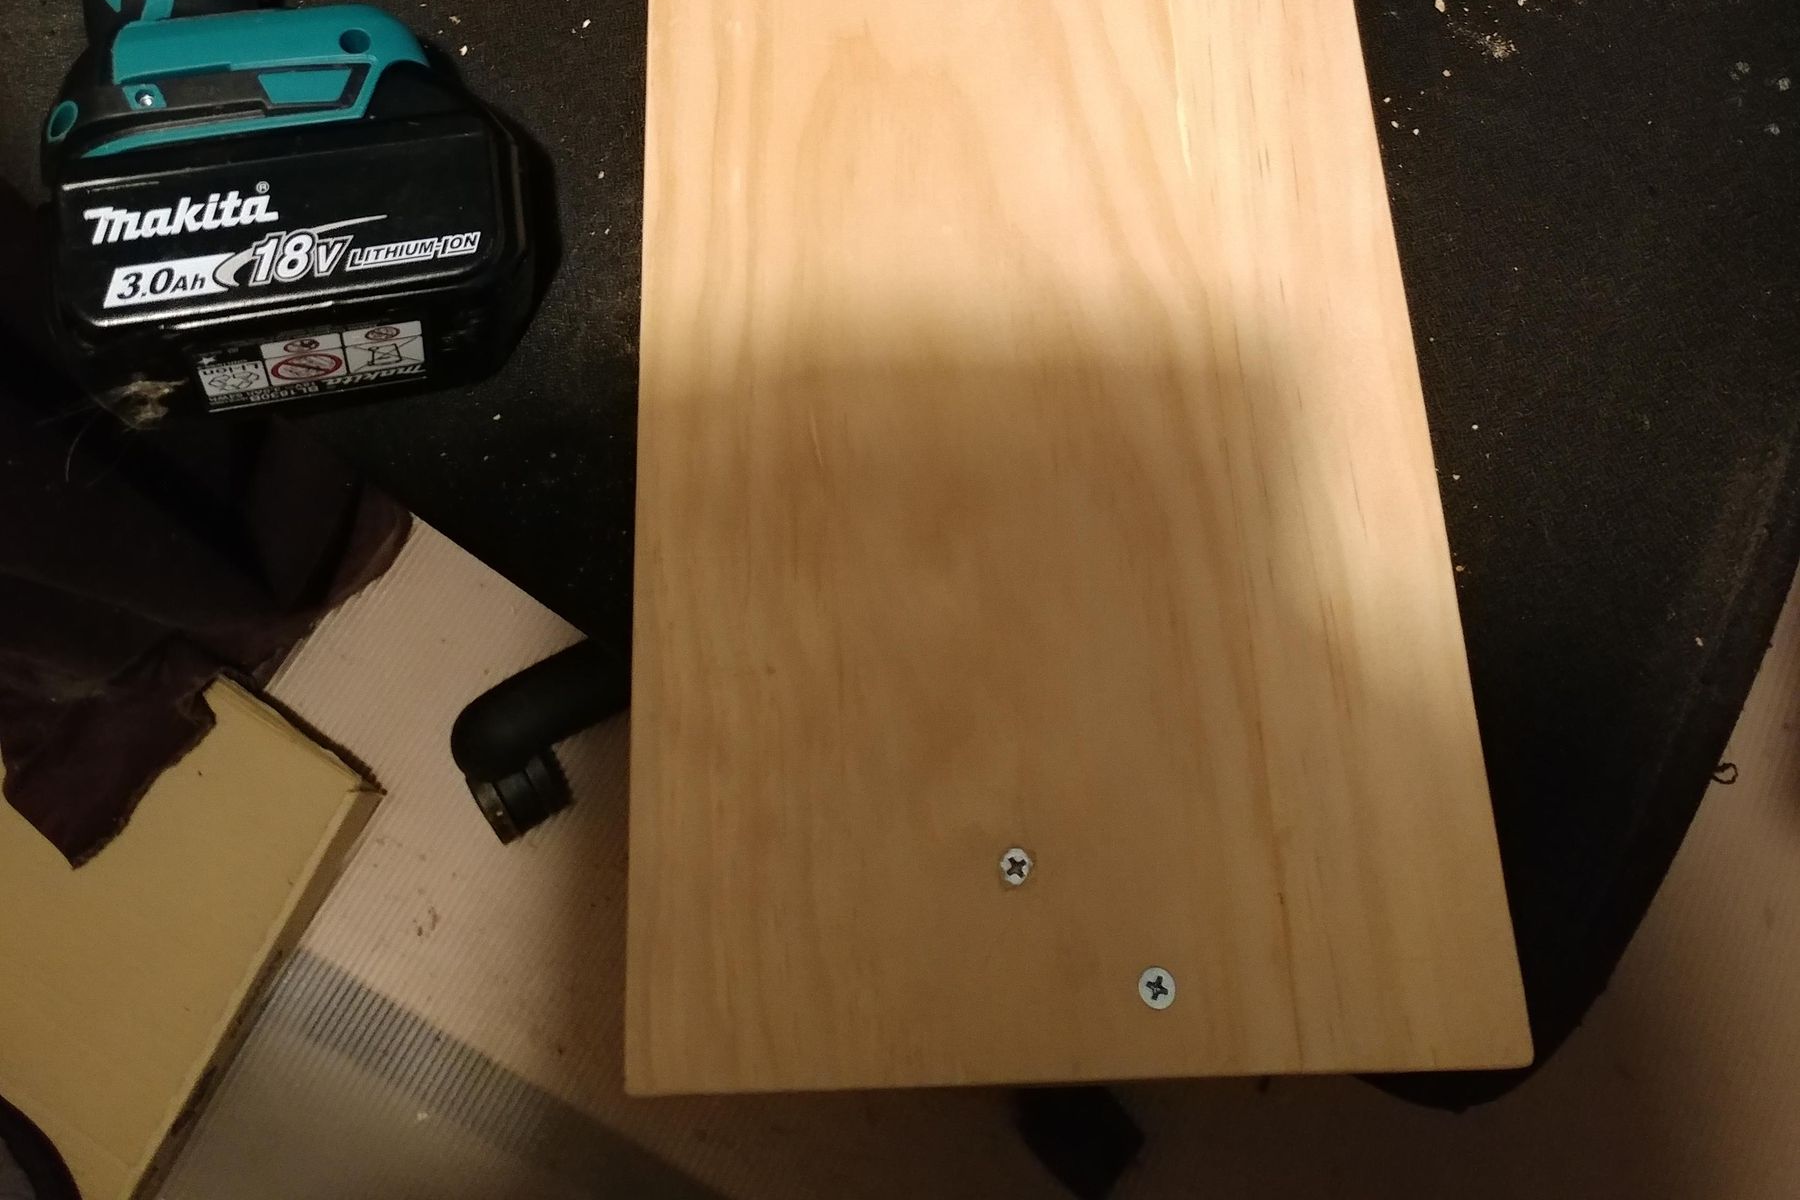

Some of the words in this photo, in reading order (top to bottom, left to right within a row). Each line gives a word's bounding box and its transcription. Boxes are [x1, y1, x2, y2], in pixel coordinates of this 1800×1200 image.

[116, 267, 206, 300] 3.0Ah
[249, 229, 354, 287] 18V
[347, 232, 481, 271] LITHIUM-ION
